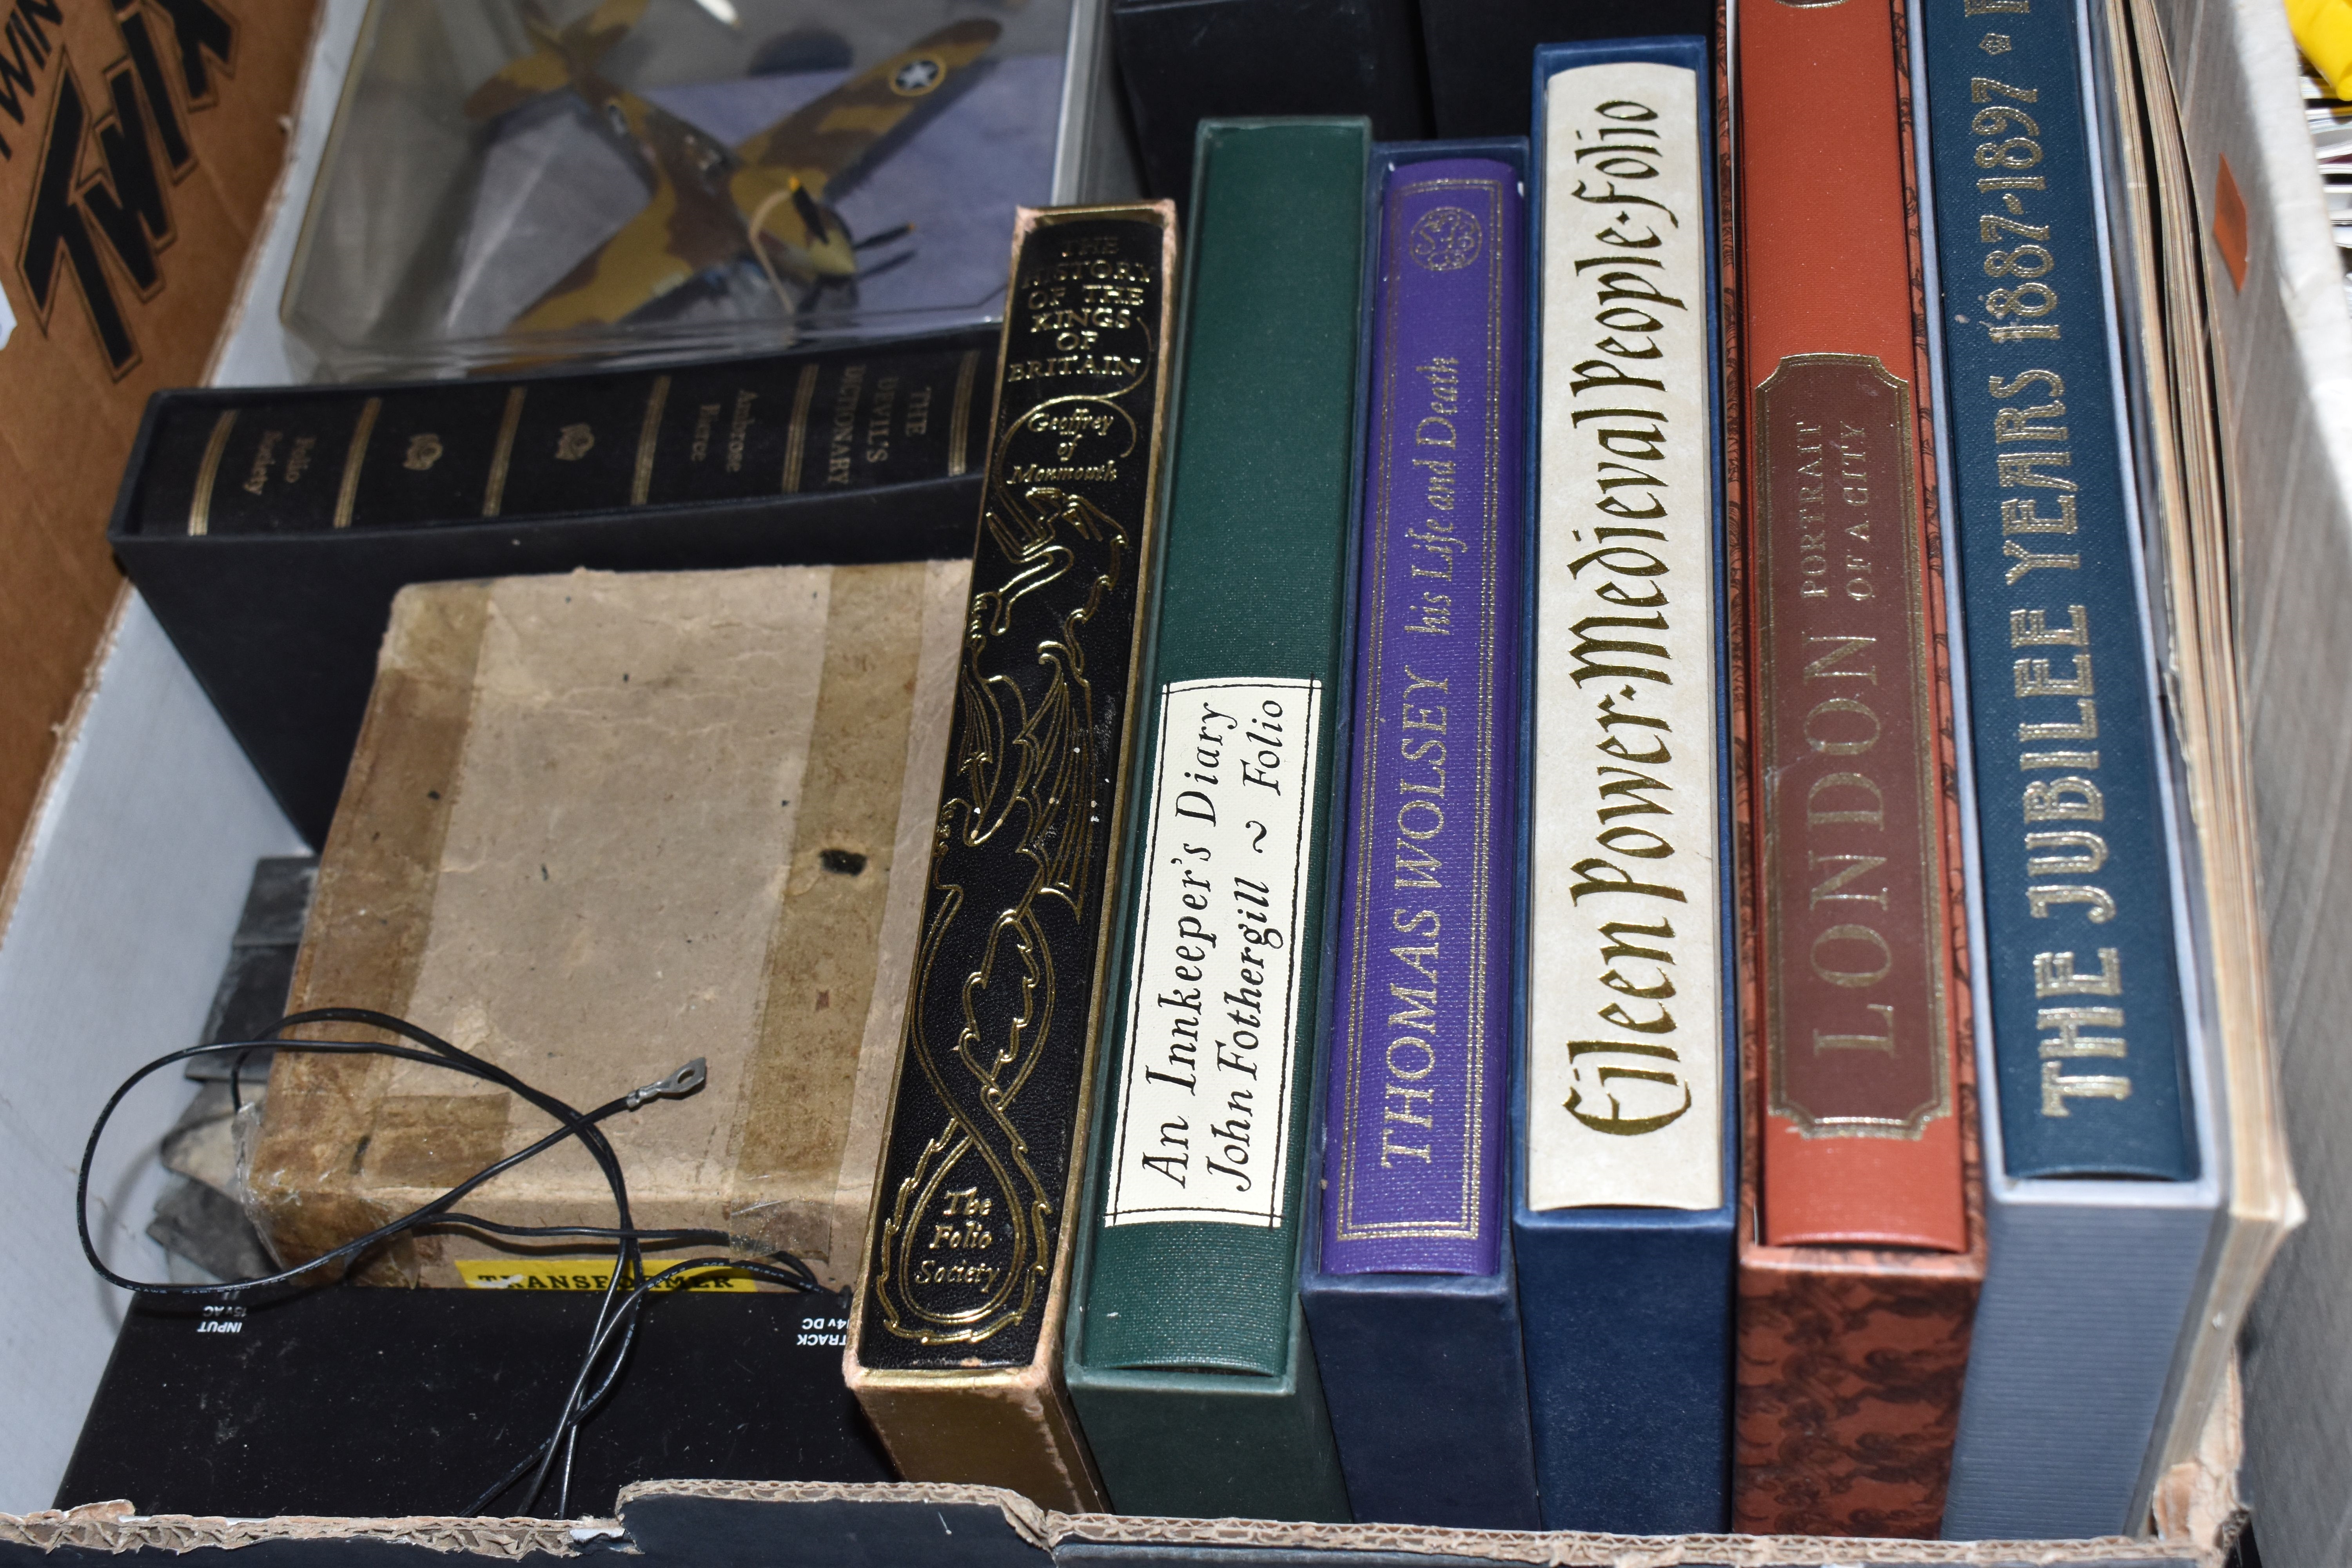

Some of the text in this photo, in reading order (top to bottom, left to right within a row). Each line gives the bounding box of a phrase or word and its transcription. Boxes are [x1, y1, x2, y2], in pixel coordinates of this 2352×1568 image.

[0, 0, 64, 161] WIN
[1062, 236, 1120, 257] THE
[1022, 260, 1156, 289] HISTORY
[1029, 285, 1144, 309] OF THE
[1031, 309, 1130, 332] KINGS
[1056, 331, 1098, 350] OF
[1008, 355, 1141, 382] BRITAIN
[828, 366, 866, 485] DICTIONARY
[867, 377, 898, 463] DEVIL'S
[906, 386, 931, 436] THE
[1027, 408, 1114, 436] Geoffrey
[1057, 434, 1083, 461] of
[1007, 460, 1117, 485] Monmouth
[1989, 369, 2081, 586] YEARS
[1796, 421, 1828, 598] PORTRAIT
[1840, 421, 1875, 601] OF A CITY
[1381, 356, 1468, 1169] THOMAS WOLSEY his Life and Death
[2010, 604, 2116, 924] JUBILEE
[1803, 631, 1896, 1058] LONDON
[1142, 702, 1238, 1189] An Innkeeper's Diary
[1205, 700, 1283, 1192] John Fothergill Folio
[1561, 915, 1692, 1136] Eileen
[2034, 948, 2131, 1118] THE
[944, 1186, 994, 1215] The
[929, 1220, 993, 1249] Folio
[915, 1259, 1000, 1294] Society
[197, 1321, 243, 1333] INPUT
[796, 1334, 847, 1346] TRACK
[802, 1318, 825, 1330] DC
